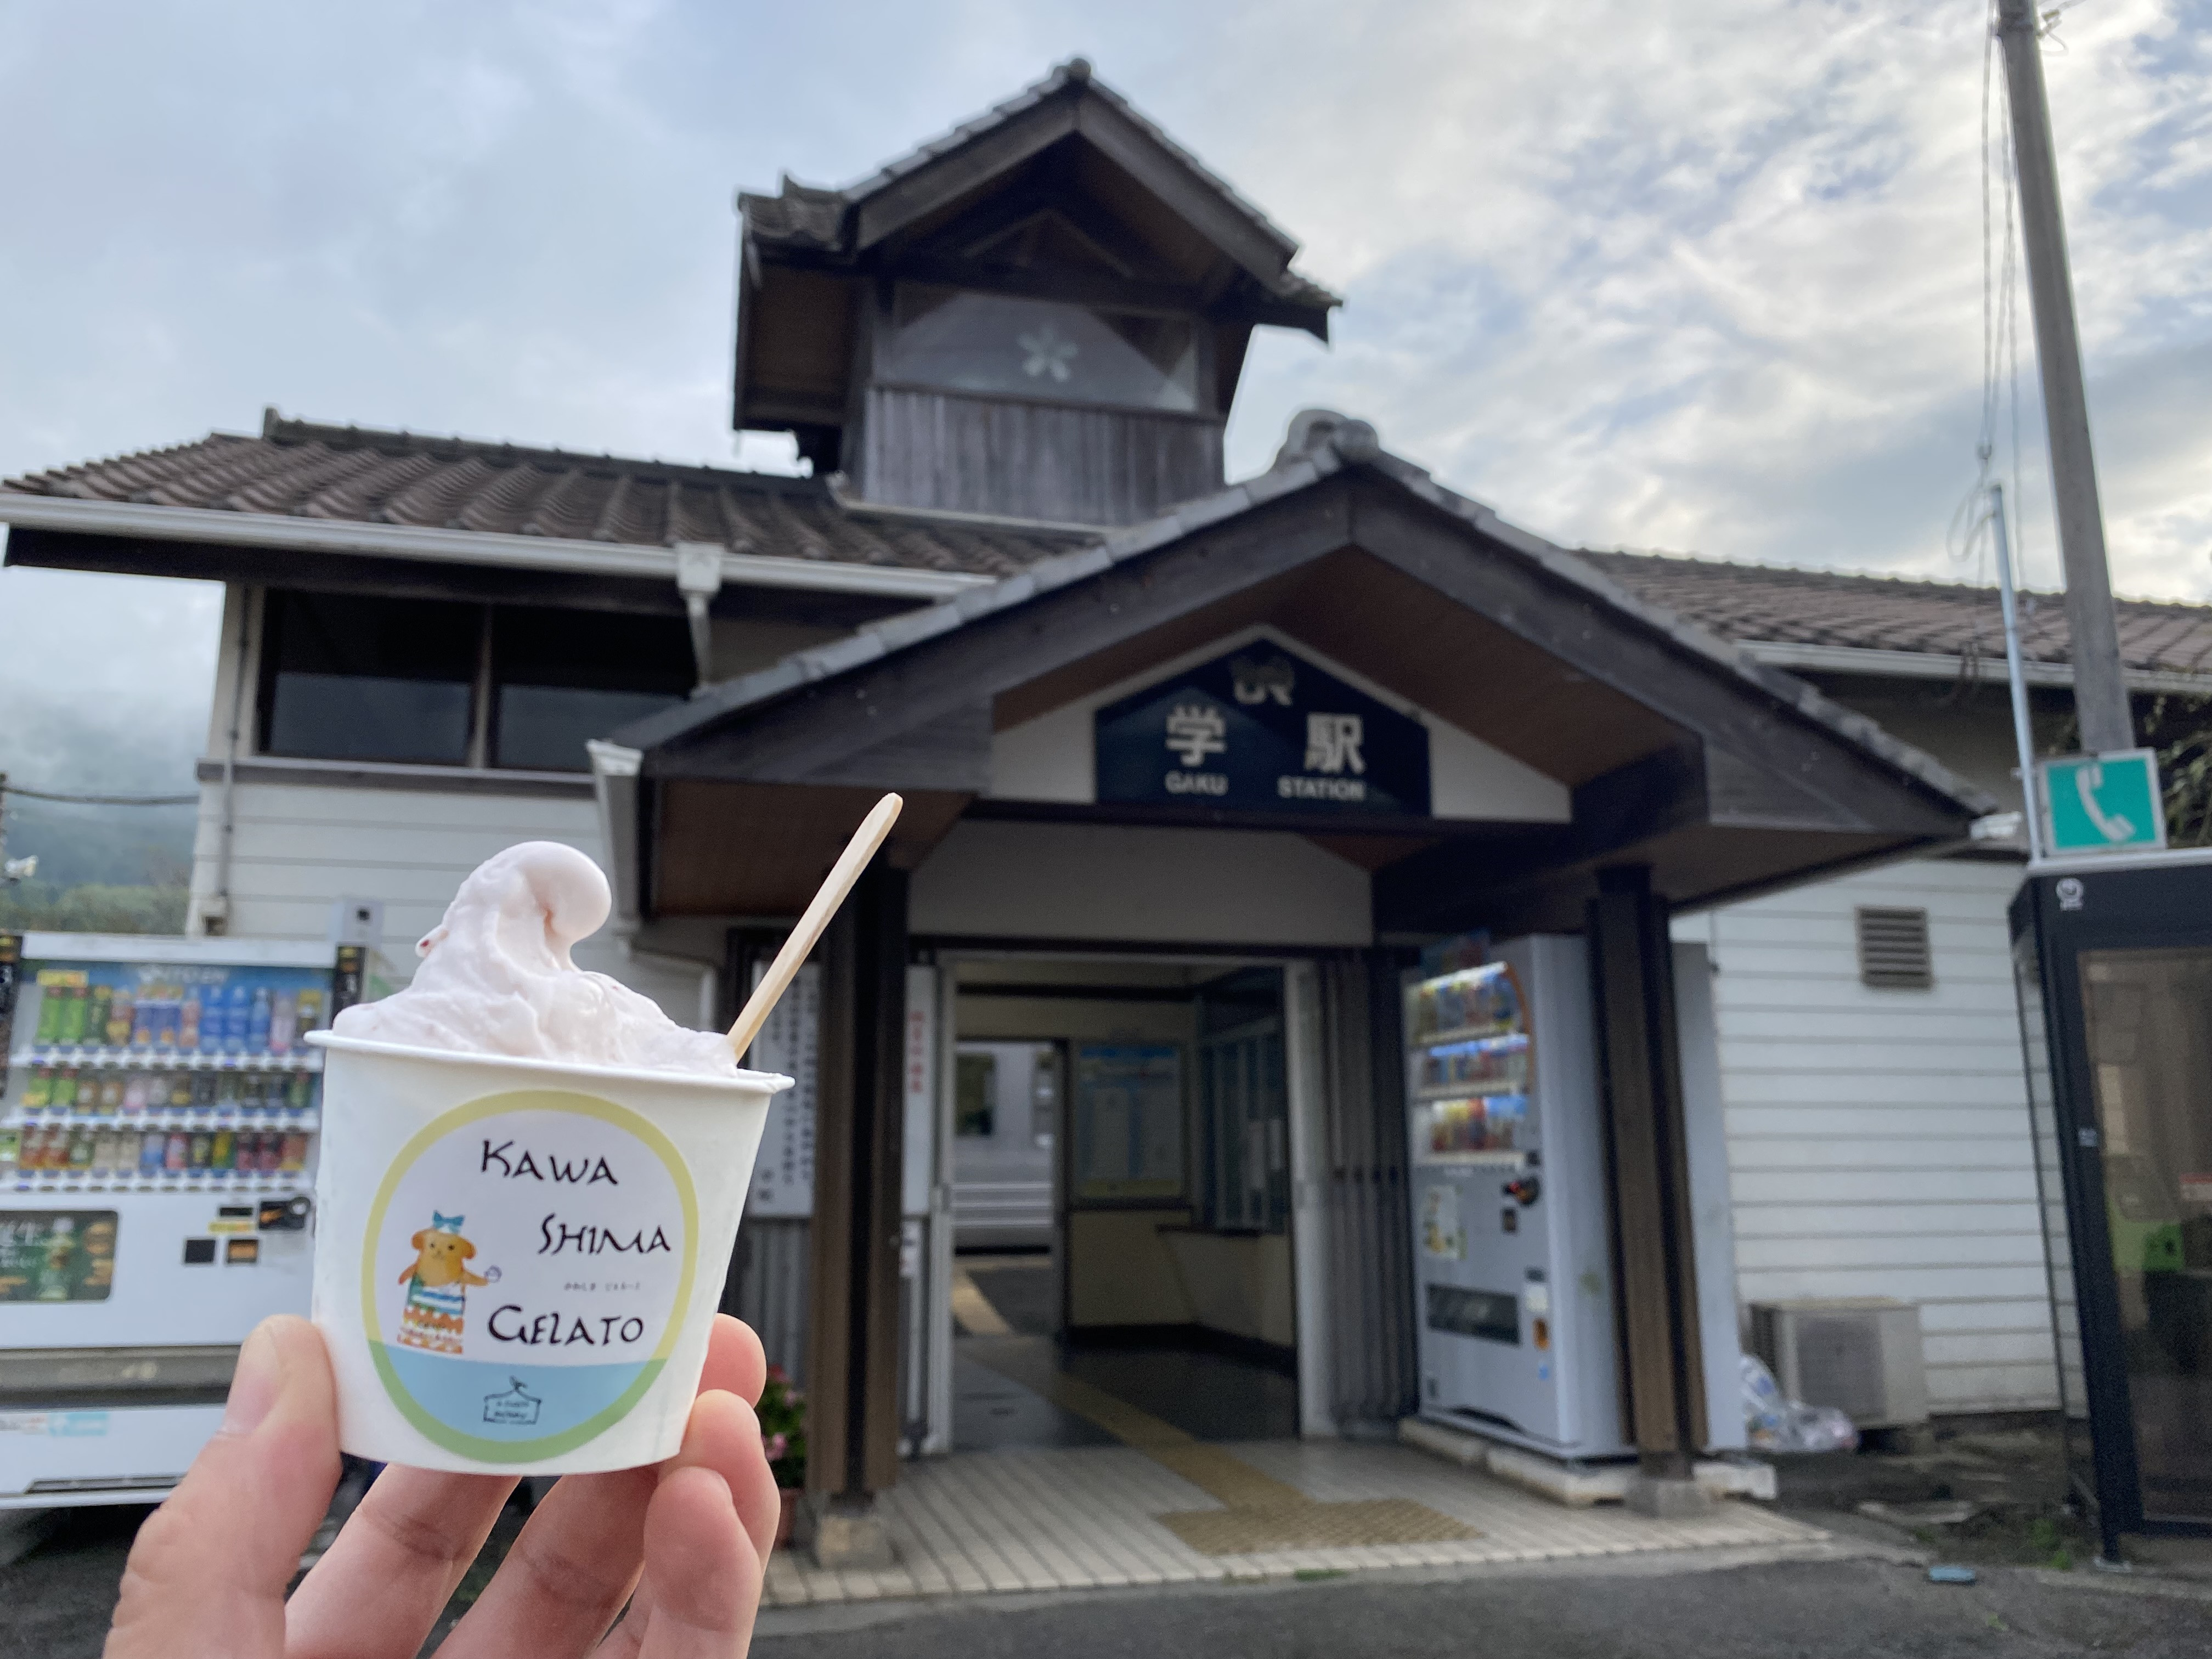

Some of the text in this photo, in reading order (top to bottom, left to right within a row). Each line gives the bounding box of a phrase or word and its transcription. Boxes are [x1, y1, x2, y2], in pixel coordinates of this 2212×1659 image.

[1166, 705, 1365, 774] 学 駅
[1165, 770, 1366, 800] GAKU STATION
[481, 1139, 618, 1186] KAWA
[538, 1212, 671, 1255] SHIMA
[488, 1304, 644, 1346] GELATO
